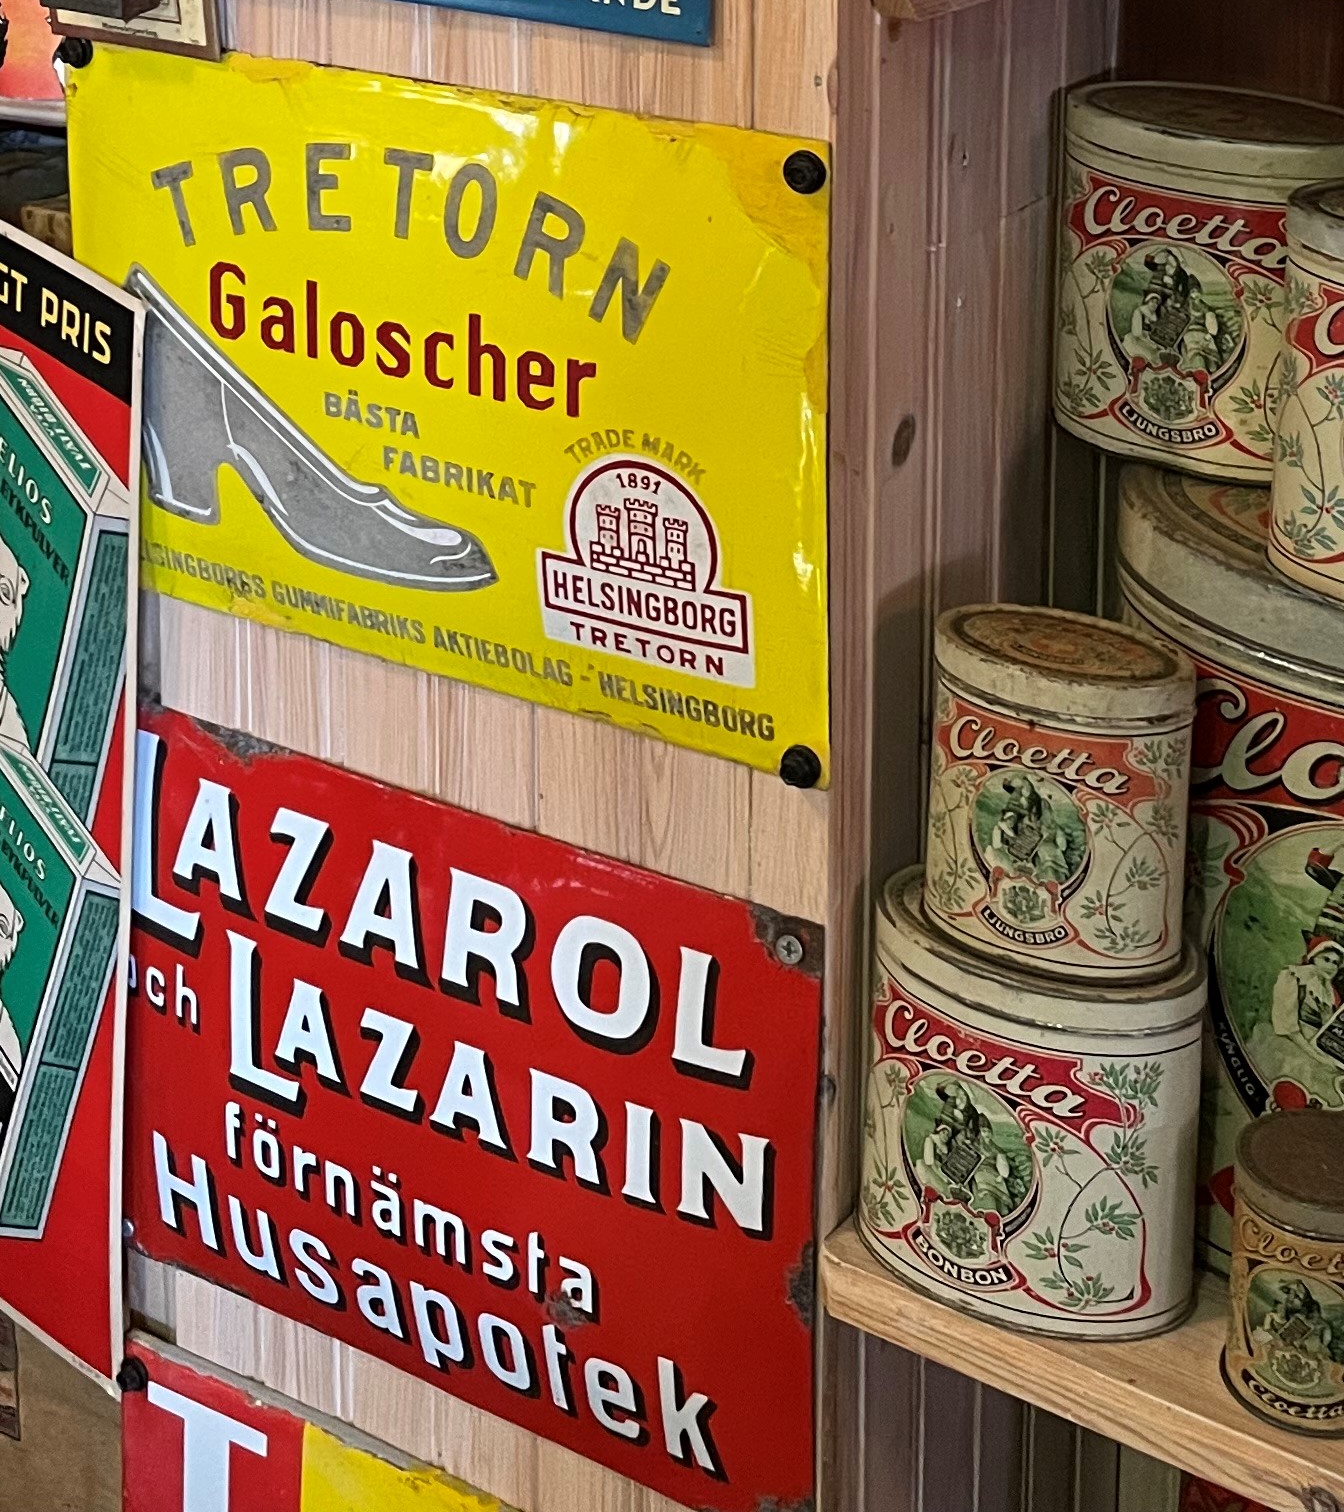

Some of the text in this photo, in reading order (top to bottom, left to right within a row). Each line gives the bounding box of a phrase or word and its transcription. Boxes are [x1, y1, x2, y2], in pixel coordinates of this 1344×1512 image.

[150, 142, 672, 345] TRETORN
[1083, 186, 1289, 269] Cloetta
[40, 292, 112, 366] PRIS
[209, 261, 597, 419] Galoscher
[323, 389, 420, 441] BÄSTA
[1121, 400, 1218, 443] LJUNGSBRO
[382, 446, 537, 510] FABRIKAT
[564, 428, 707, 484] TRADE MARK
[615, 472, 663, 496] 1891
[552, 569, 738, 638] HELSINGBORG
[270, 579, 776, 743] GUMMIFABRIKS AKTIEBOLAG HELSINGBORG
[569, 621, 726, 677] TRETORN
[950, 714, 1130, 795] Cloetta
[131, 728, 752, 1089] LAZAROL
[982, 908, 1067, 945] LJUNGSBRO
[226, 928, 770, 1236] LAZARIN
[884, 998, 1084, 1118] Cloetta
[224, 1099, 596, 1322] förnämsta
[915, 1233, 1009, 1285] BONBON
[151, 1128, 728, 1482] Husapotek
